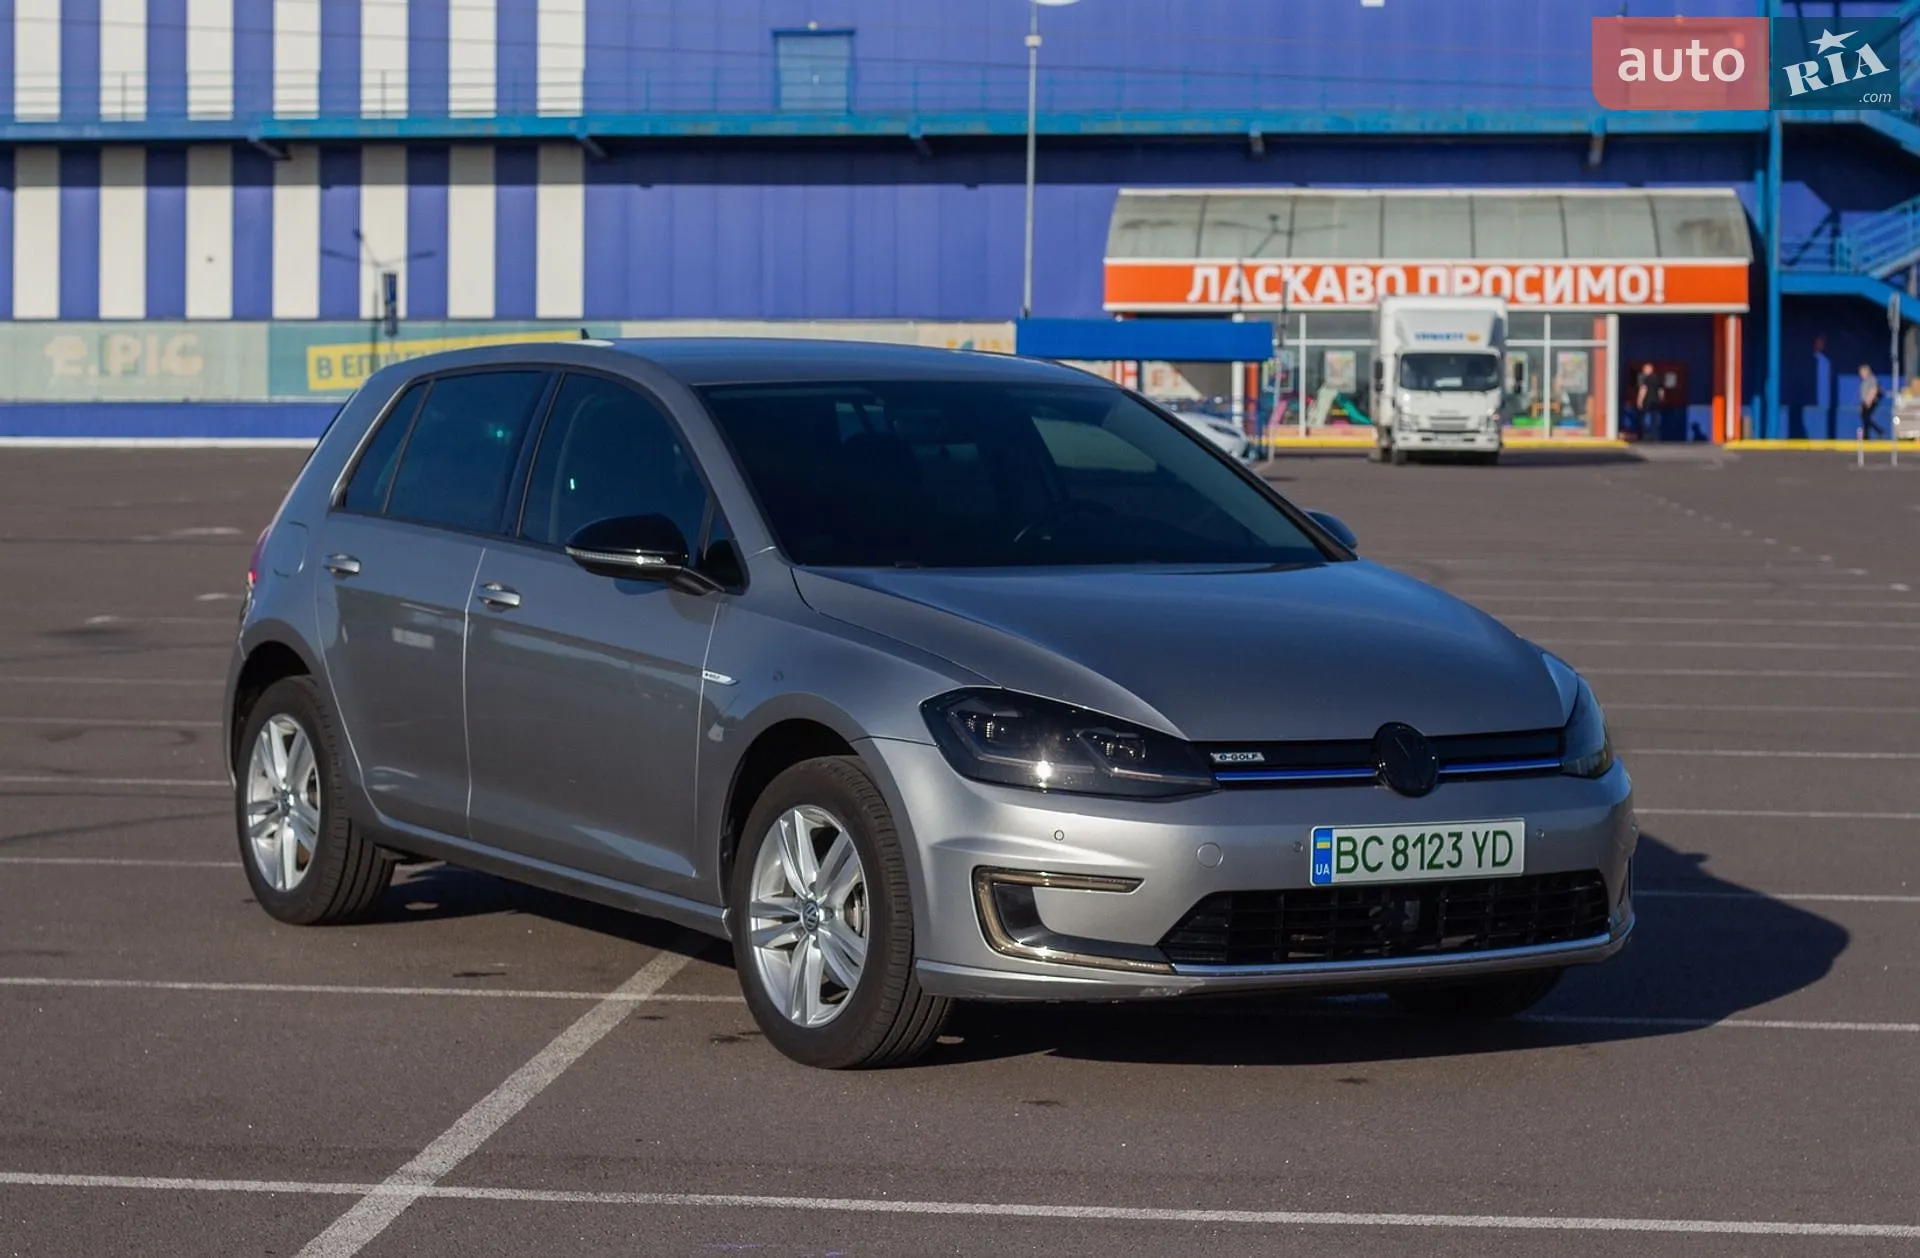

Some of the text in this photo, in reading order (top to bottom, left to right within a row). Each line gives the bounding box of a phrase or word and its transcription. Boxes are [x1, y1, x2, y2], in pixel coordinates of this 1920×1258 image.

[1186, 266, 1665, 304] ЛАСКАВО ПРОСИМО!
[1315, 863, 1330, 876] UA
[1335, 830, 1513, 874] BC 8123 YD
